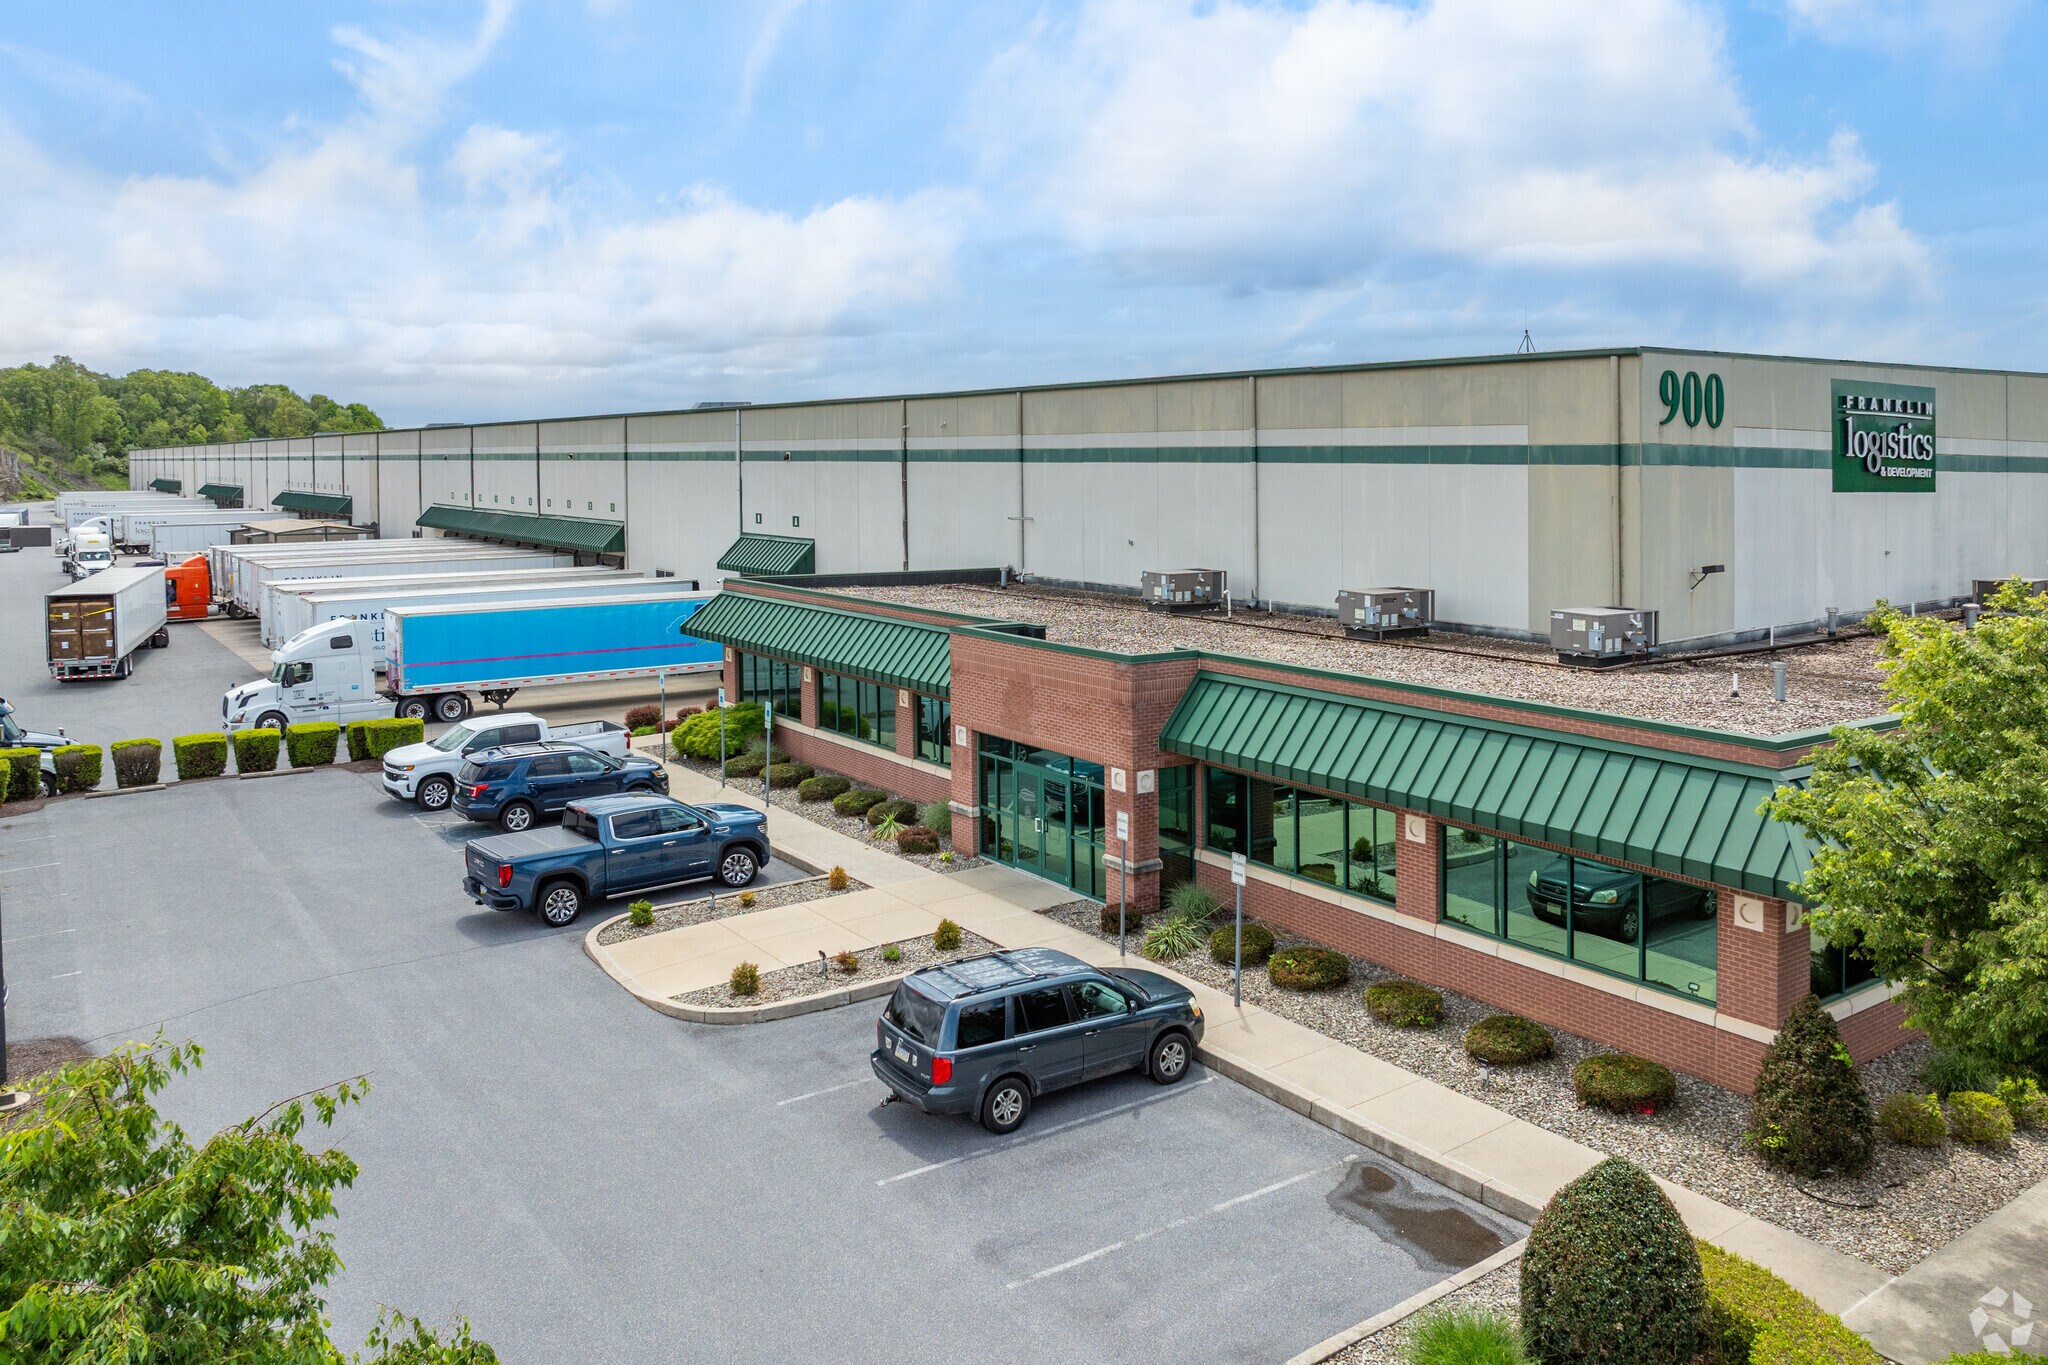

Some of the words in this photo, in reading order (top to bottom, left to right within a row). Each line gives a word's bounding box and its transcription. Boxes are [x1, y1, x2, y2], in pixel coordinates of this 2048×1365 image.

[1659, 370, 1725, 429] 900
[1846, 395, 1933, 415] FRANKLIN
[1845, 416, 1933, 473] logistics
[1880, 466, 1887, 477] &
[1887, 467, 1933, 478] DEVELOPMENT
